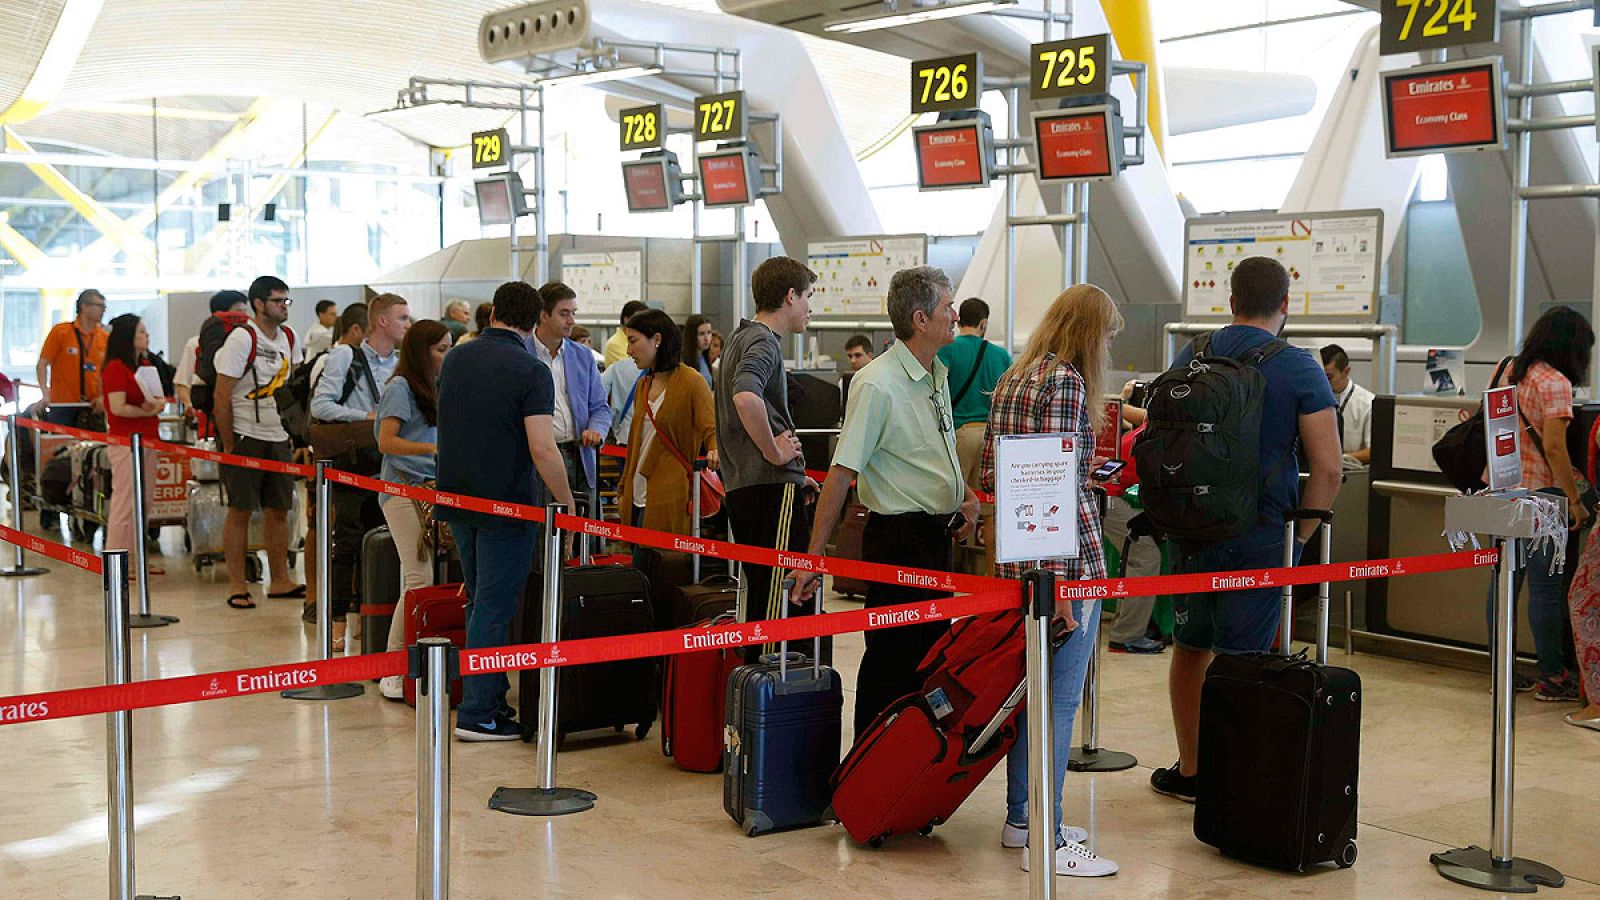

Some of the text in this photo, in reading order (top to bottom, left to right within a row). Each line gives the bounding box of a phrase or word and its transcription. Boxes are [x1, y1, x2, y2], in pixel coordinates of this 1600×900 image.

[1396, 0, 1477, 41] 724
[1039, 46, 1096, 89] 725
[919, 63, 968, 104] 726
[1409, 79, 1454, 95] Emirates
[623, 112, 657, 145] 728
[699, 99, 736, 134] 727
[1416, 112, 1468, 125] Economy Class
[474, 135, 501, 163] 729
[153, 487, 186, 499] ERP
[492, 504, 513, 514] Emirates
[584, 522, 612, 536] Emirates
[674, 538, 705, 553] Emirates
[778, 554, 813, 570] Emirates
[1350, 564, 1389, 578] Emirates
[1474, 552, 1498, 565] Emira
[897, 570, 938, 587] Emirates
[1059, 585, 1108, 599] Emirates
[1212, 575, 1256, 589] Emirates
[683, 631, 743, 649] Emirates
[868, 609, 920, 627] Emirates
[468, 652, 538, 672] Emirates
[0, 700, 49, 720] rates
[236, 668, 318, 692] Emirates
